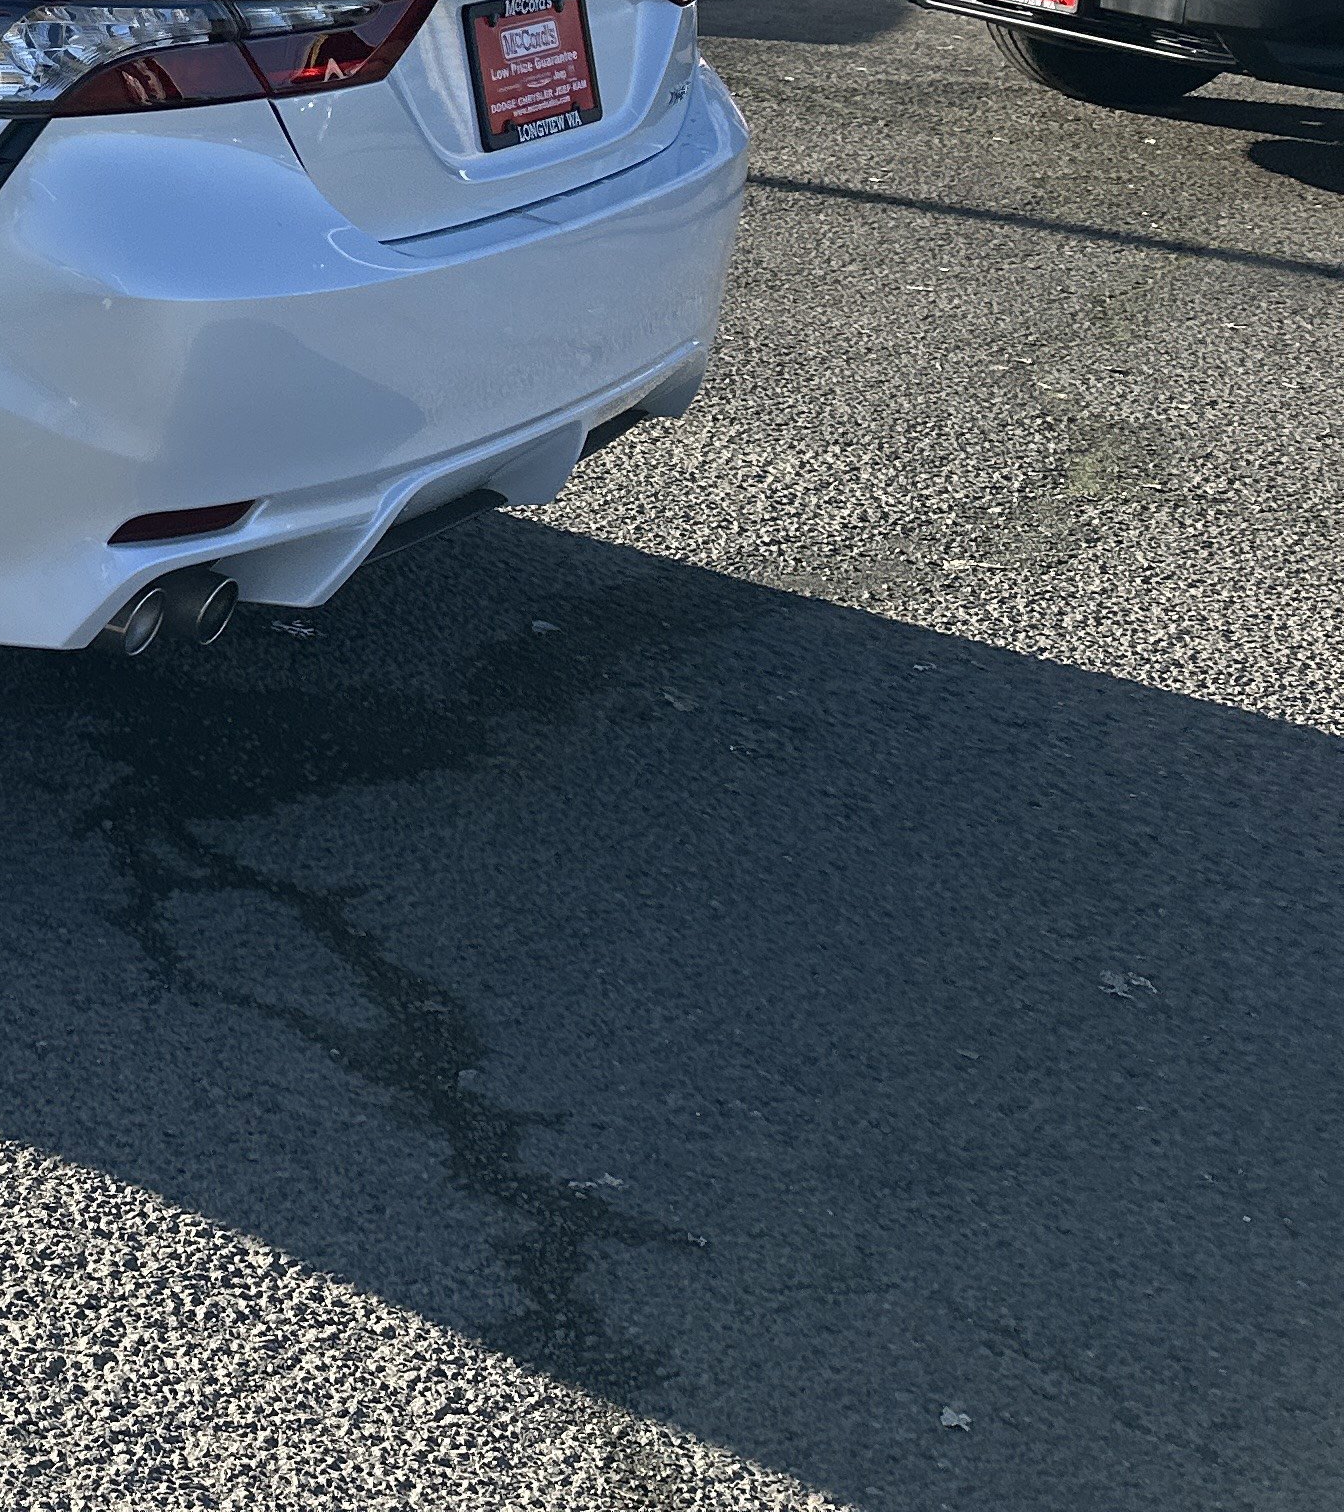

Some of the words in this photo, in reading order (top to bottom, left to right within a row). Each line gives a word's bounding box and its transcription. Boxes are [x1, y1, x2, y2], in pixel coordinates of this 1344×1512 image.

[502, 23, 558, 56] McCord's
[491, 67, 510, 81] Low
[510, 61, 533, 76] Price
[534, 50, 578, 70] Guarantee
[490, 97, 518, 114] DODGE
[517, 114, 565, 143] LONGVIEW
[565, 110, 583, 128] WA
